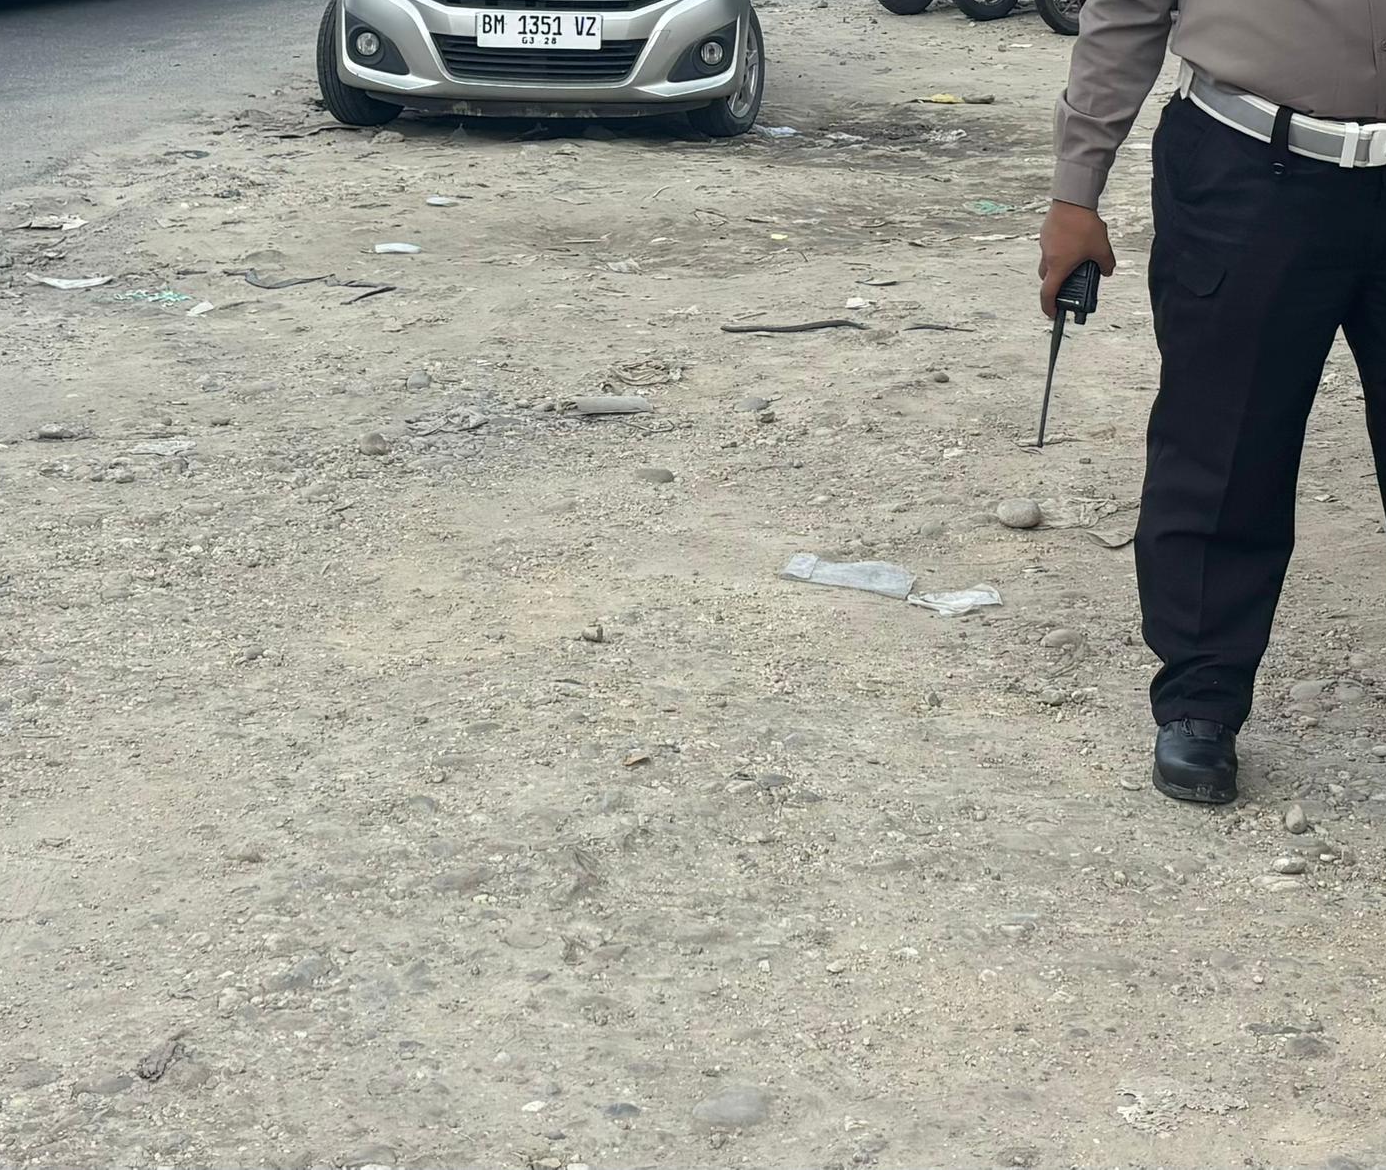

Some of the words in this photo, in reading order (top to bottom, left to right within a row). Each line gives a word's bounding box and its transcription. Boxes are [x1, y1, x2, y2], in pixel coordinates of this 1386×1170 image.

[482, 14, 505, 35] BM
[517, 15, 563, 36] 1351
[574, 16, 597, 36] VZ
